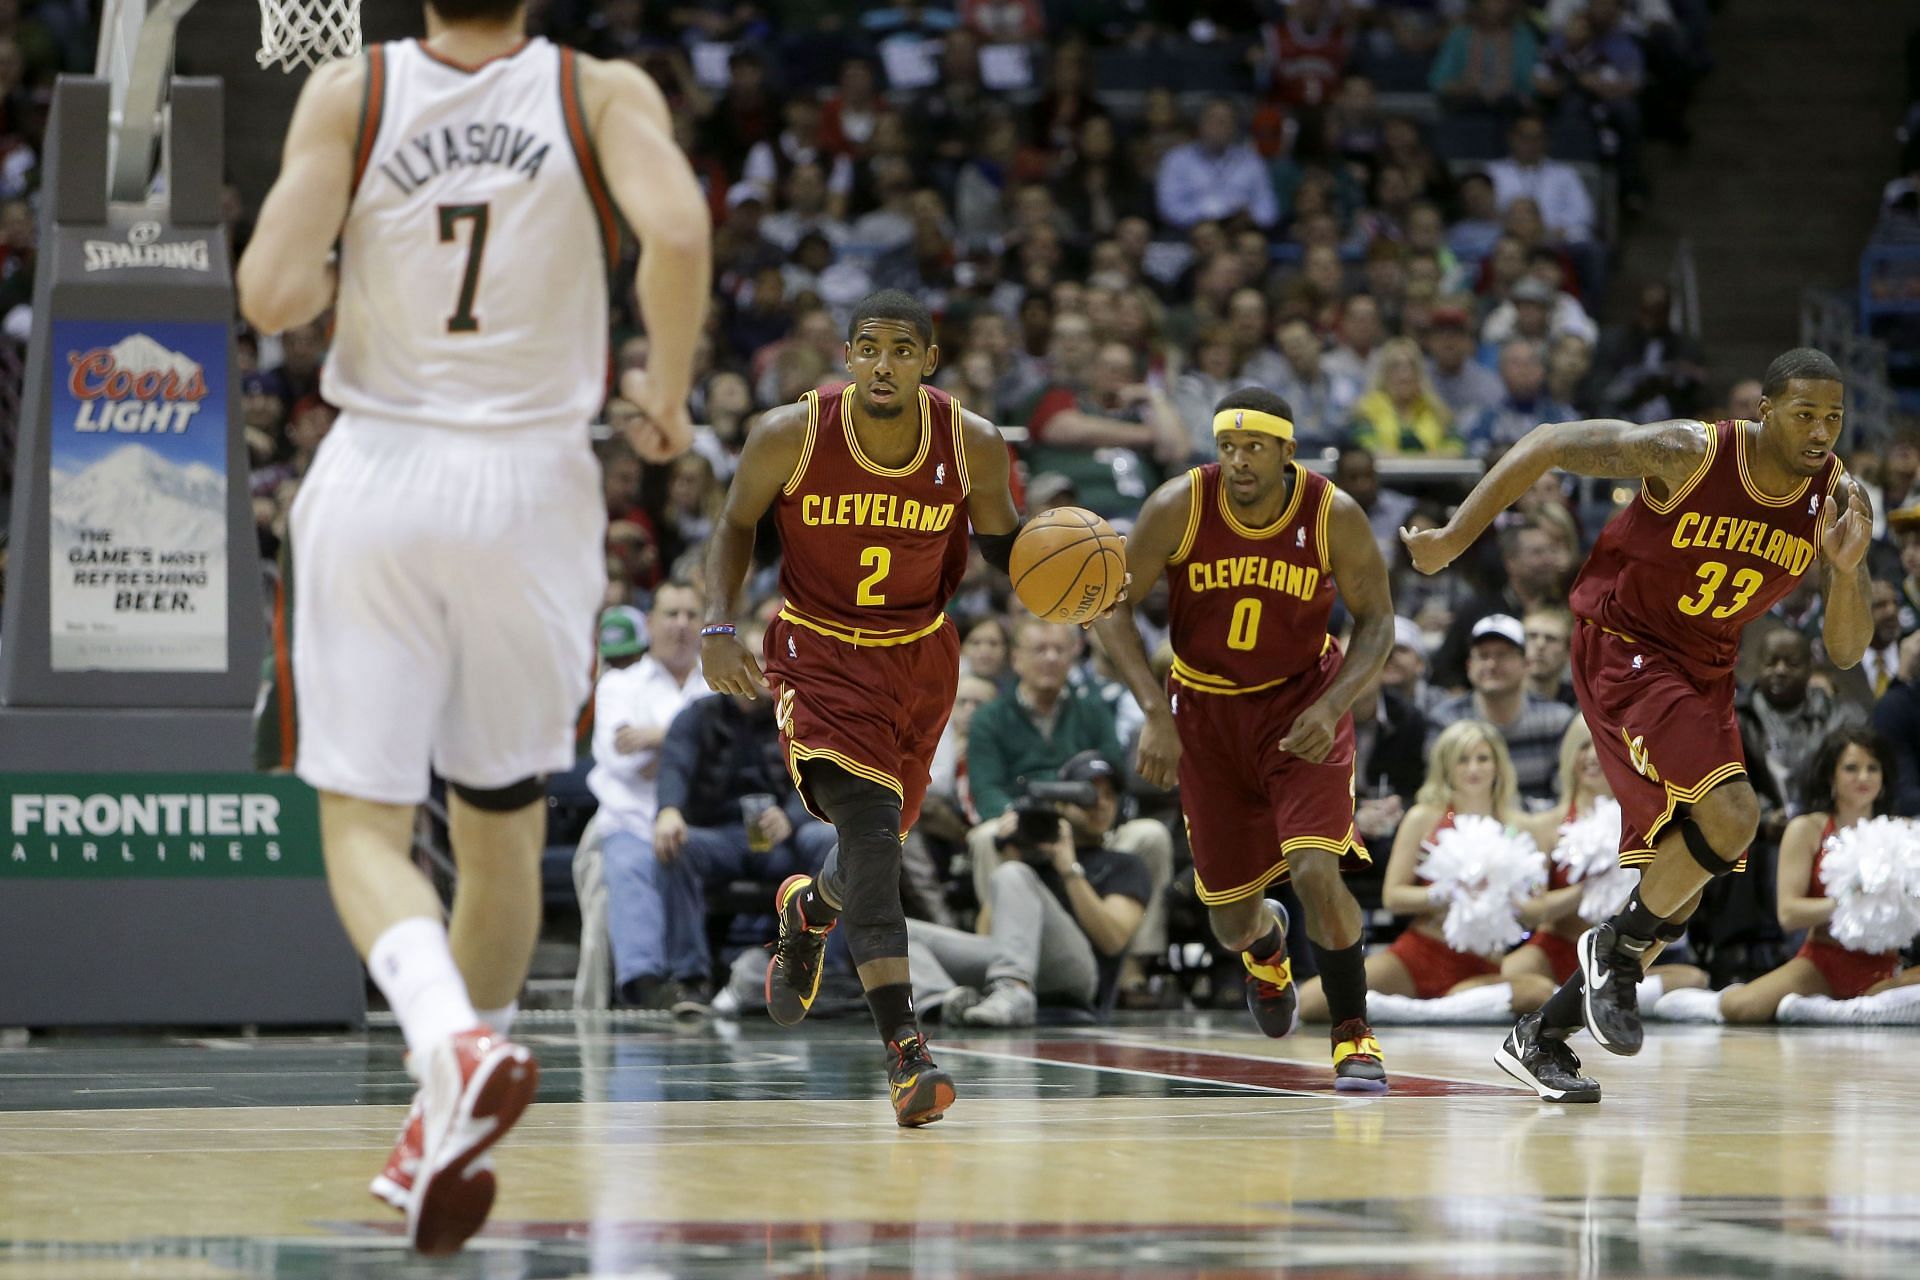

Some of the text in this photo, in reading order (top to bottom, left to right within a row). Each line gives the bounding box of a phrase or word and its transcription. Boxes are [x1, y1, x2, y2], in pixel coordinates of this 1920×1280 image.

[379, 123, 552, 195] ILYASOVA
[84, 239, 209, 272] SPALDING
[437, 202, 490, 333] 7
[67, 349, 207, 401] Coors
[75, 399, 200, 433] LIGHT
[802, 493, 955, 532] CLEVELAND
[1672, 512, 1814, 576] CLEVELAND
[73, 571, 207, 586] REFRESHING
[856, 546, 892, 606] 2
[1188, 556, 1319, 601] CLEVELAND
[1677, 561, 1764, 619] 33
[114, 591, 195, 612] BEER.
[1227, 597, 1263, 651] 0
[11, 793, 281, 836] FRONTIER
[11, 842, 281, 862] AIRLINES
